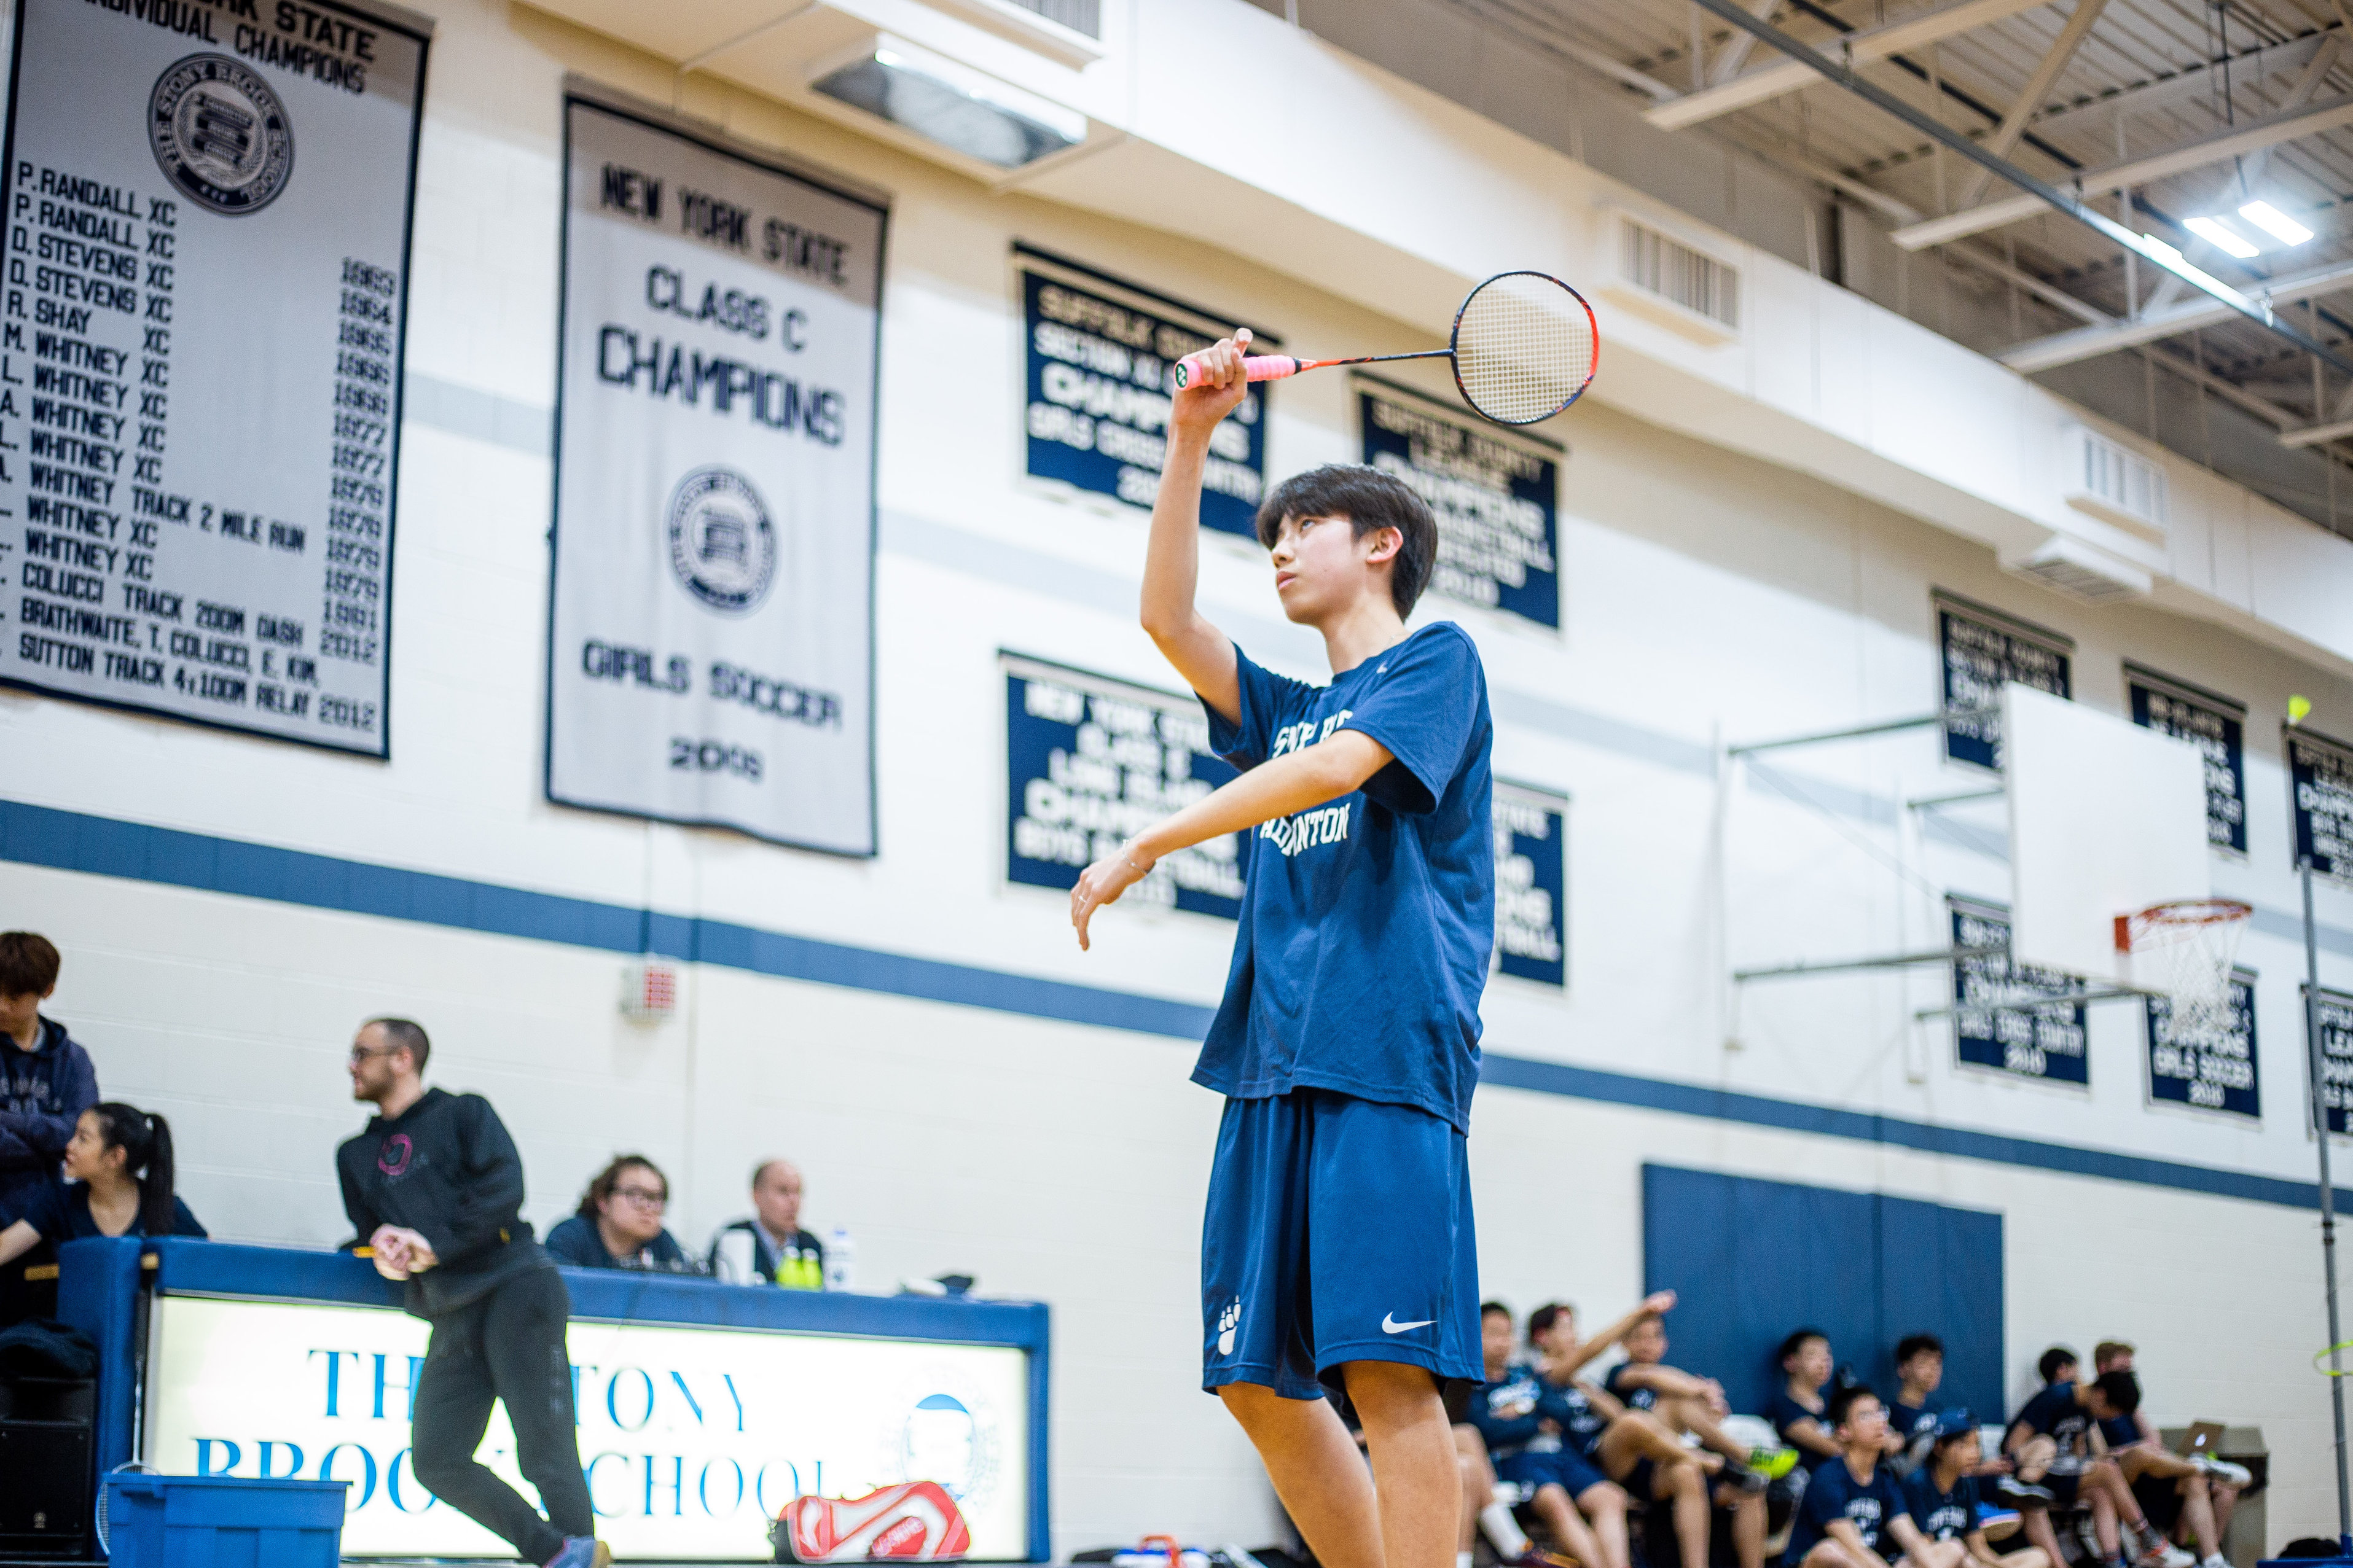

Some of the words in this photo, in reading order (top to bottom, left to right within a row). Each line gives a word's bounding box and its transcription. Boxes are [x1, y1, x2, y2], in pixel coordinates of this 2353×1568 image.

[86, 0, 217, 44] IVIDUAL
[235, 23, 367, 96] CHAMPIONS
[276, 1, 377, 61] STATE
[40, 168, 141, 219] RANDALL
[148, 197, 177, 227] XC
[599, 161, 664, 222] NEW
[676, 185, 754, 255] YORK
[762, 216, 851, 287] STATE
[39, 200, 139, 251] RANDALL
[146, 228, 176, 260] XC
[37, 232, 138, 283] STEVENS
[145, 261, 174, 292] XC
[35, 265, 137, 314] STEVENS
[144, 294, 173, 324] XC
[646, 263, 771, 343] CLASS
[781, 307, 810, 354] C
[4, 321, 26, 353] M.
[35, 329, 130, 378] WHITNEY
[140, 356, 170, 389] XC
[34, 297, 92, 335] SHAY
[142, 324, 171, 356] XC
[34, 362, 130, 410] WHITNEY
[138, 389, 168, 421] XC
[596, 322, 847, 450] CHAMPIONS
[32, 396, 127, 443] WHITNEY
[137, 421, 166, 453] XC
[31, 429, 125, 475] WHITNEY
[133, 453, 162, 485] XC
[28, 493, 122, 541] WHITNEY
[129, 518, 159, 550] XC
[30, 461, 115, 505] WHITNEY
[131, 484, 192, 528] TRACK
[199, 501, 214, 533] 2
[220, 507, 264, 545] MILE
[268, 519, 307, 556] RUN
[25, 527, 119, 576] WHITNEY
[125, 551, 154, 582] XC
[22, 561, 105, 604] COLUCCI
[122, 583, 185, 623] TRACK
[195, 599, 246, 638] 200M
[256, 613, 305, 650] DASH
[320, 628, 378, 668] 2012
[19, 631, 95, 673] SUTTON
[103, 650, 165, 688] TRACK
[256, 681, 311, 717] RELAY
[318, 695, 377, 733] 2012
[581, 637, 692, 697] GIRLS
[708, 659, 844, 733] SOCCER
[308, 1349, 427, 1421] TH
[571, 1364, 746, 1433] TONY
[190, 1437, 437, 1513] BROO
[582, 1451, 825, 1518] CHOOL
